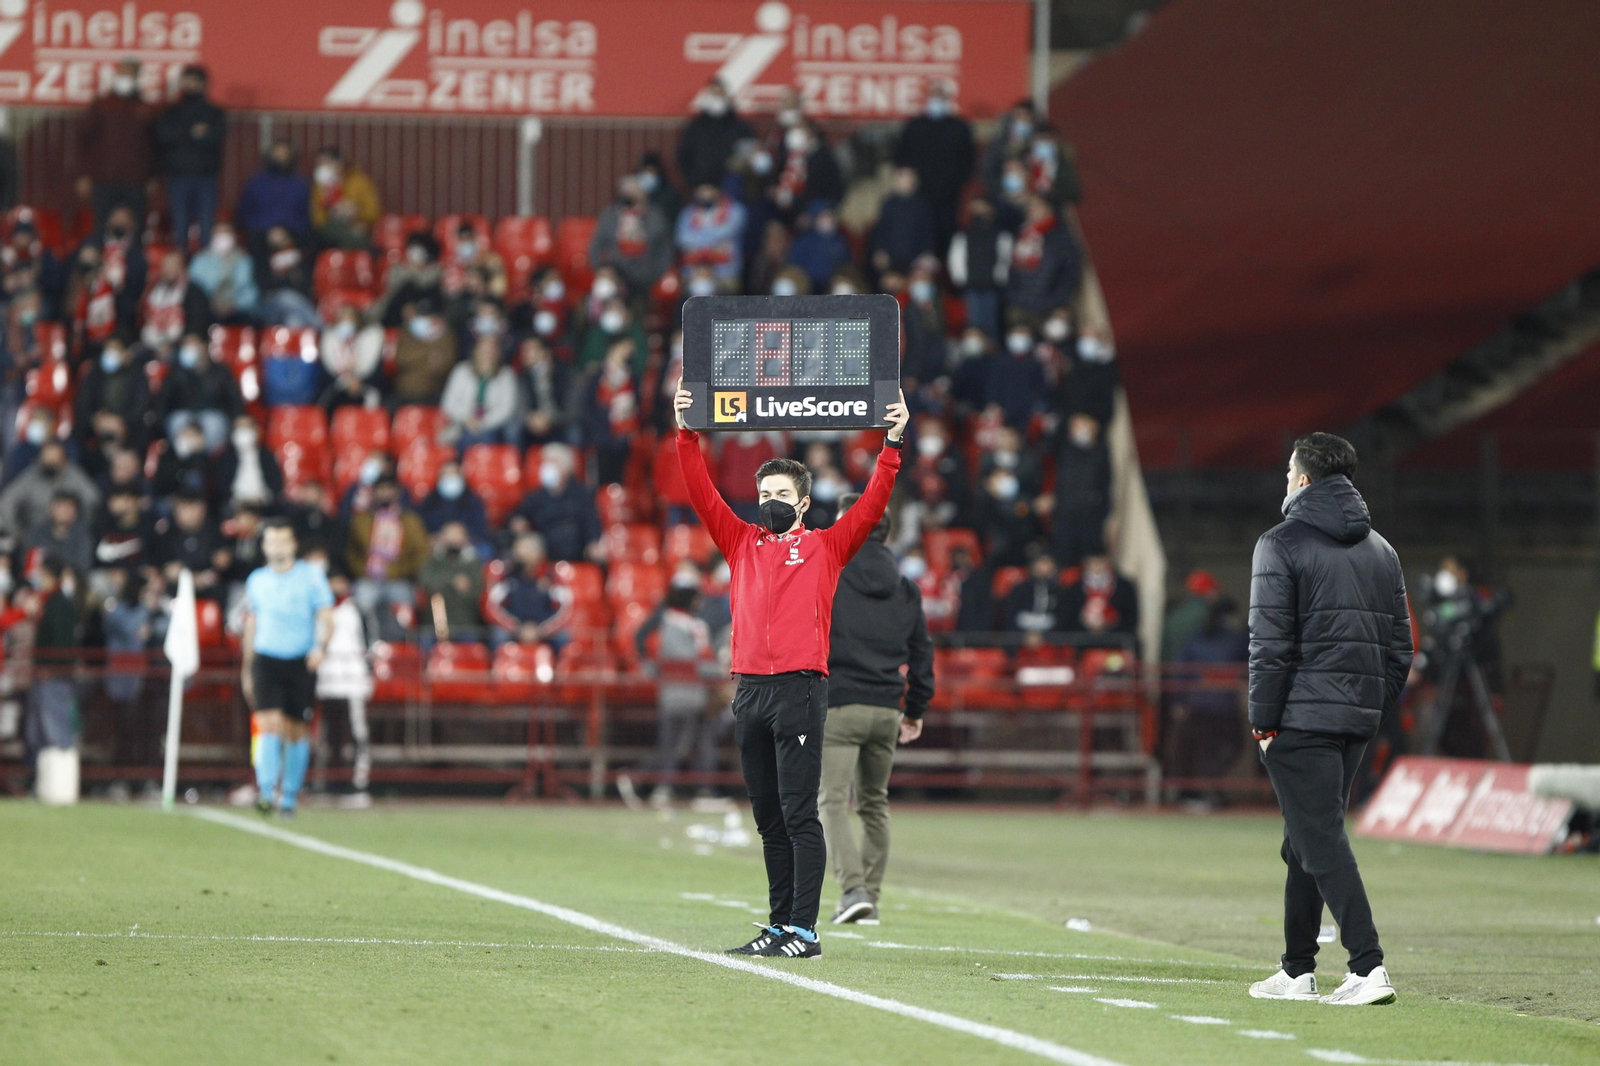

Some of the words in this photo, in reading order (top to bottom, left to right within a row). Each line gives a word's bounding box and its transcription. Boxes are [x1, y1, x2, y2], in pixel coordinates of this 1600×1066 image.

[32, 2, 202, 49] inelsa
[428, 9, 597, 56] inelsa
[793, 14, 962, 62] inelsa
[428, 71, 596, 111] ZENER
[720, 397, 741, 417] LS
[756, 396, 868, 417] LiveScore
